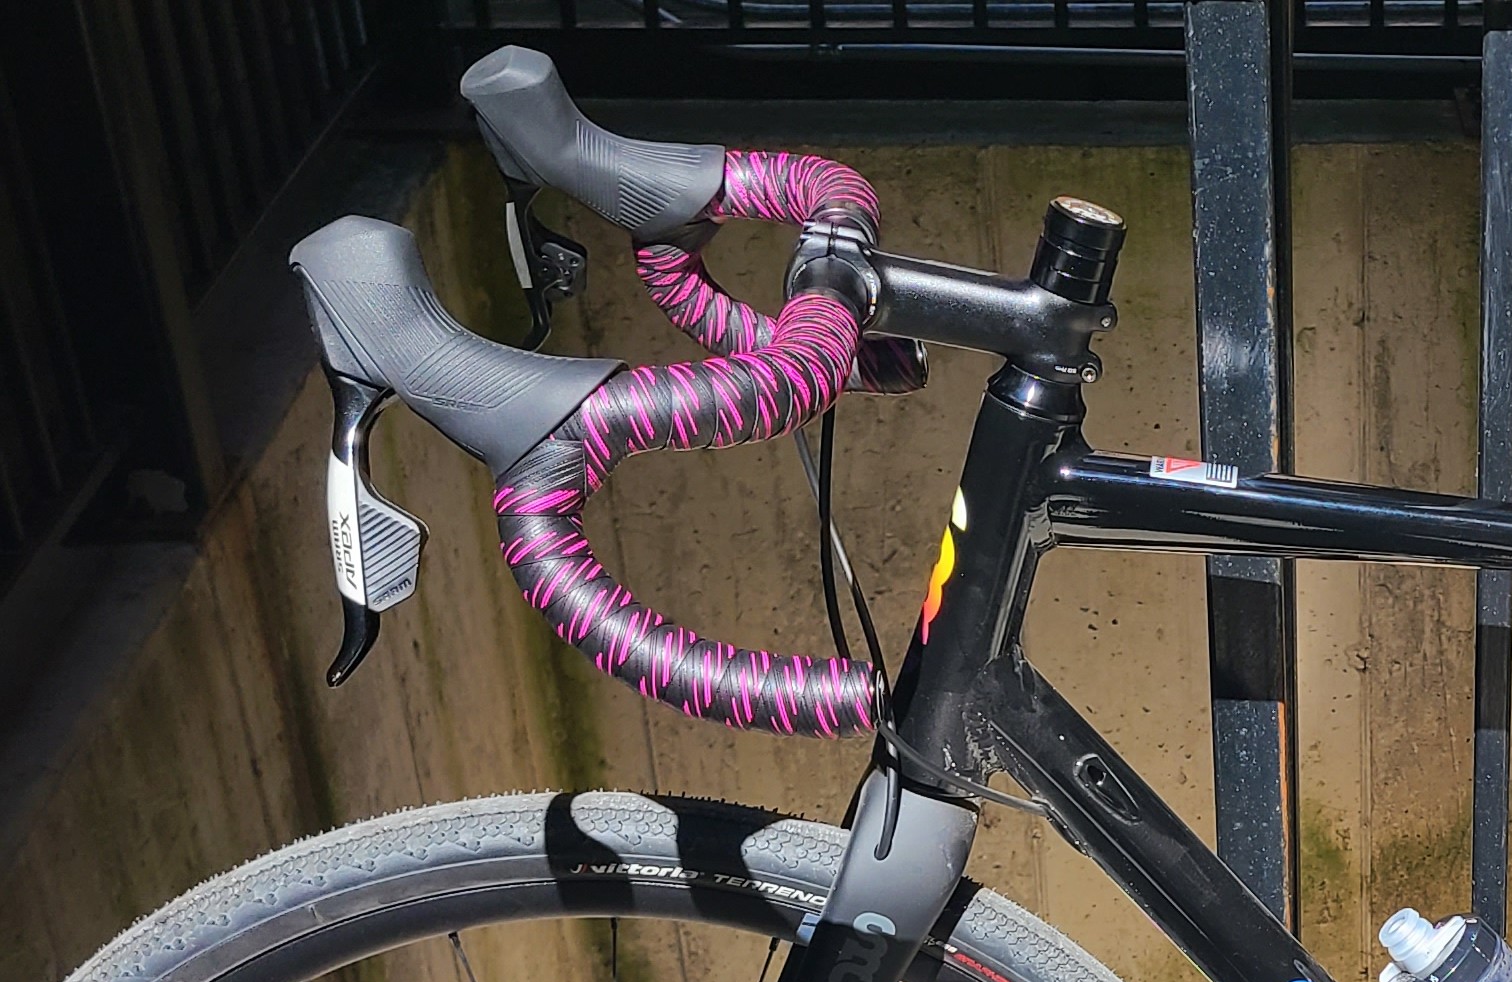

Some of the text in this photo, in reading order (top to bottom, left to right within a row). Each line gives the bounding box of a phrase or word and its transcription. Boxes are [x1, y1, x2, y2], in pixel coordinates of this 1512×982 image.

[339, 511, 357, 590] APEX
[591, 863, 828, 906] vittoria TERRENO
